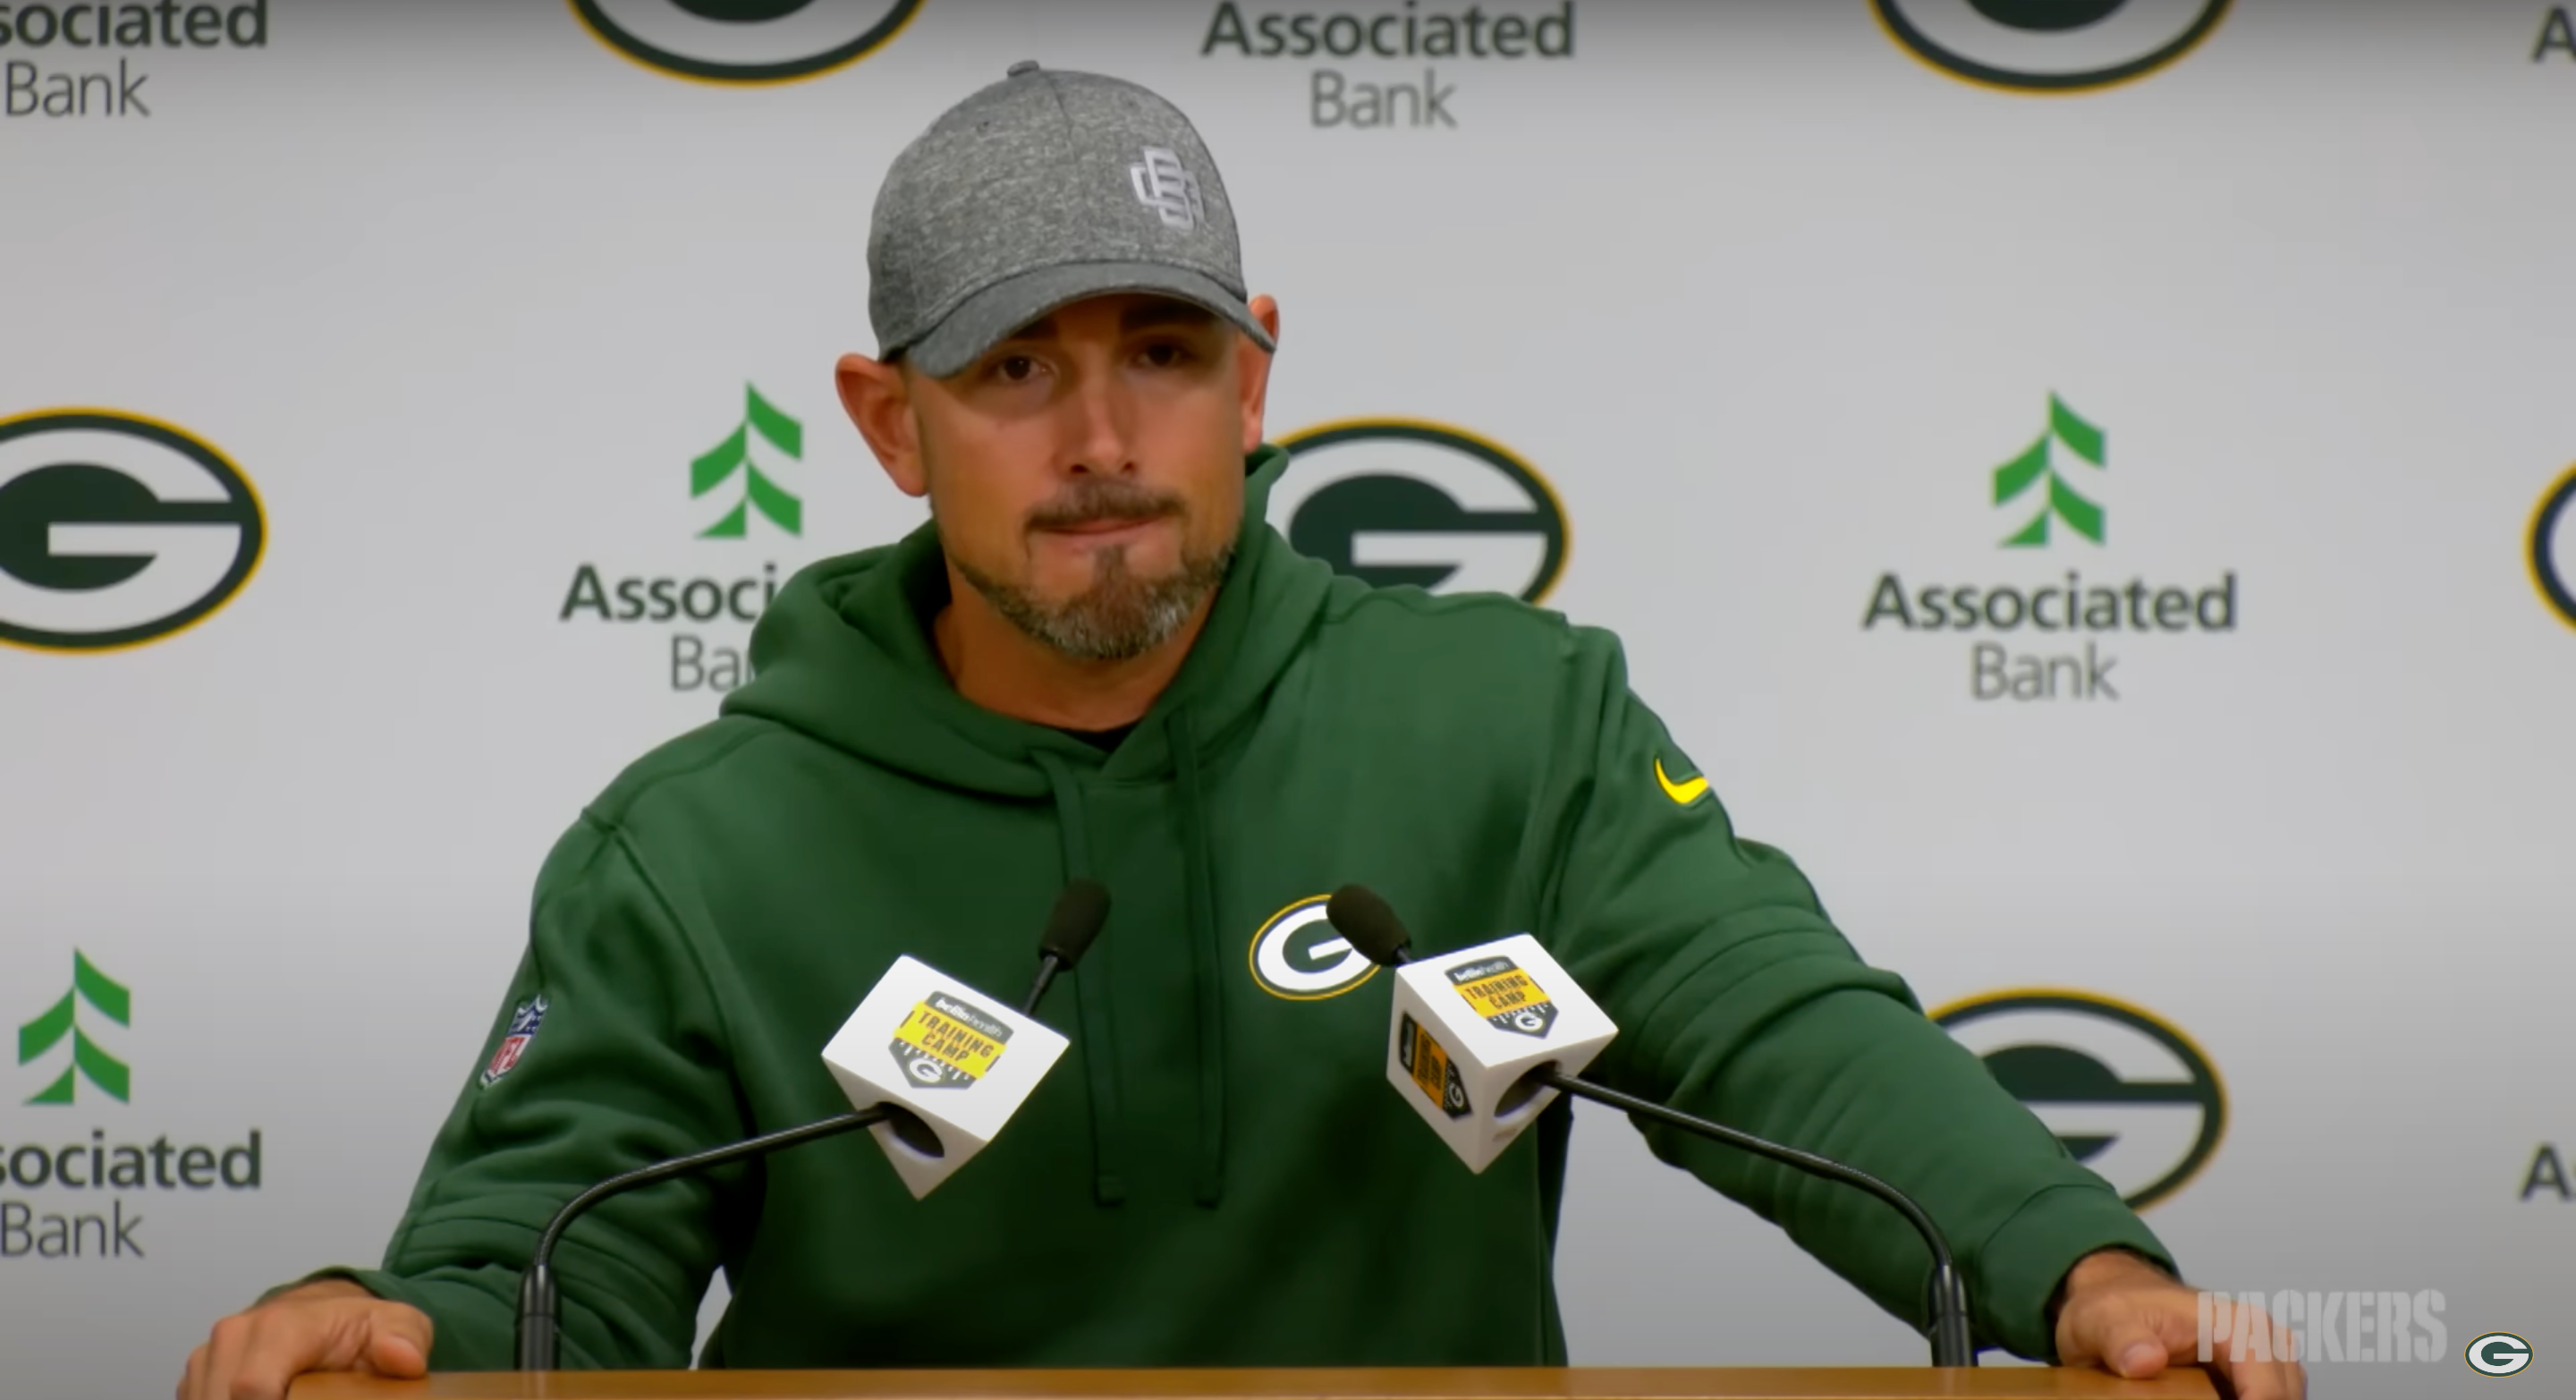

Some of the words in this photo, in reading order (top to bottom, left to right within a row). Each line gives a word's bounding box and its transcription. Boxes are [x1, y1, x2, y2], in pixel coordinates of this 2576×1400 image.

[1200, 0, 1575, 59] Associated
[5, 55, 150, 118] Bank
[1310, 68, 1459, 129] Bank
[560, 562, 776, 623] Associ
[1861, 570, 2239, 632] Associated
[671, 632, 755, 692] Ba
[1970, 641, 2121, 701] Bank
[1256, 903, 1372, 993] G
[1464, 974, 1529, 1000] TRAINING
[1488, 990, 1527, 1010] CAMP
[918, 1010, 996, 1058] TRAINING
[921, 1031, 970, 1062] CAMP
[0, 1128, 262, 1190] ociated
[0, 1199, 144, 1258] Bank
